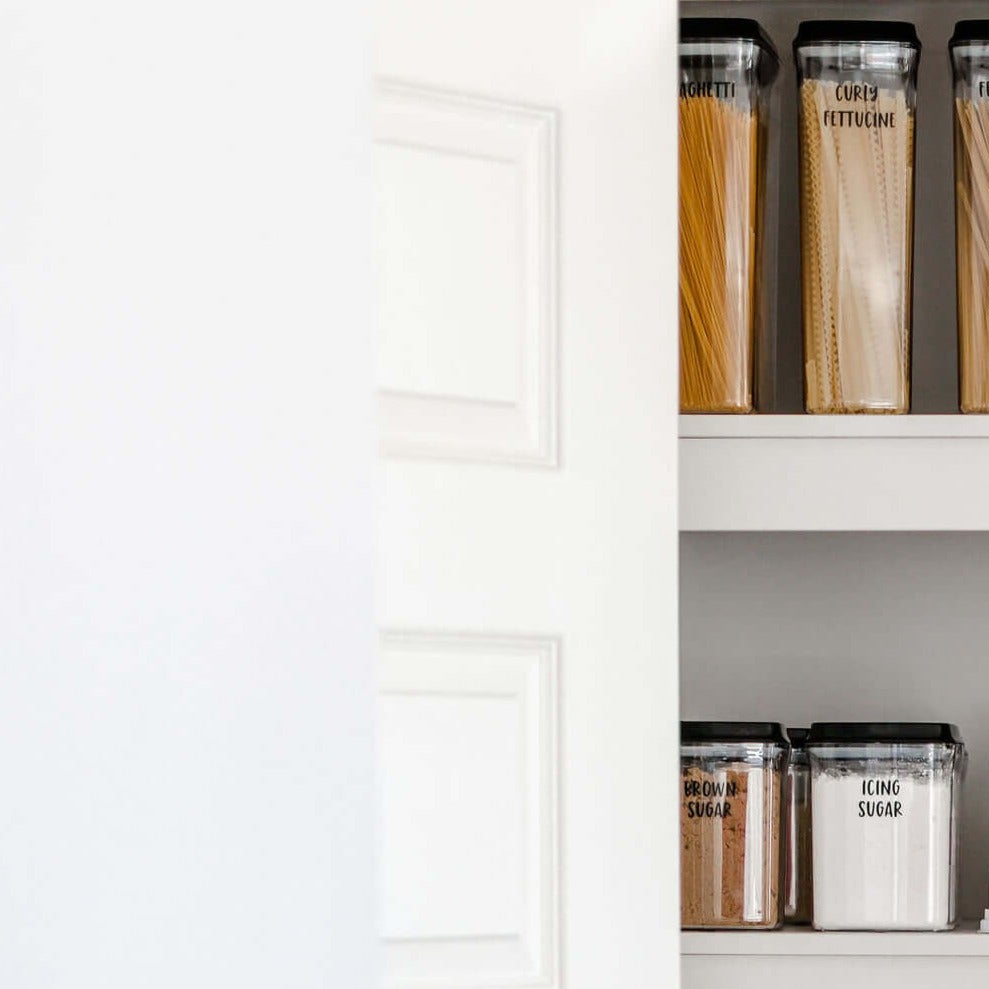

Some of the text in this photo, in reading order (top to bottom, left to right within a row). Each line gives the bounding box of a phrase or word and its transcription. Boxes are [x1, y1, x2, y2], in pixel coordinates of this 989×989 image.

[835, 85, 878, 102] CURLY
[823, 110, 896, 129] FETTUCINE
[684, 780, 738, 798] BROWN
[861, 779, 901, 796] ICING
[687, 801, 732, 819] SUGAR
[858, 801, 903, 818] SUGAR
